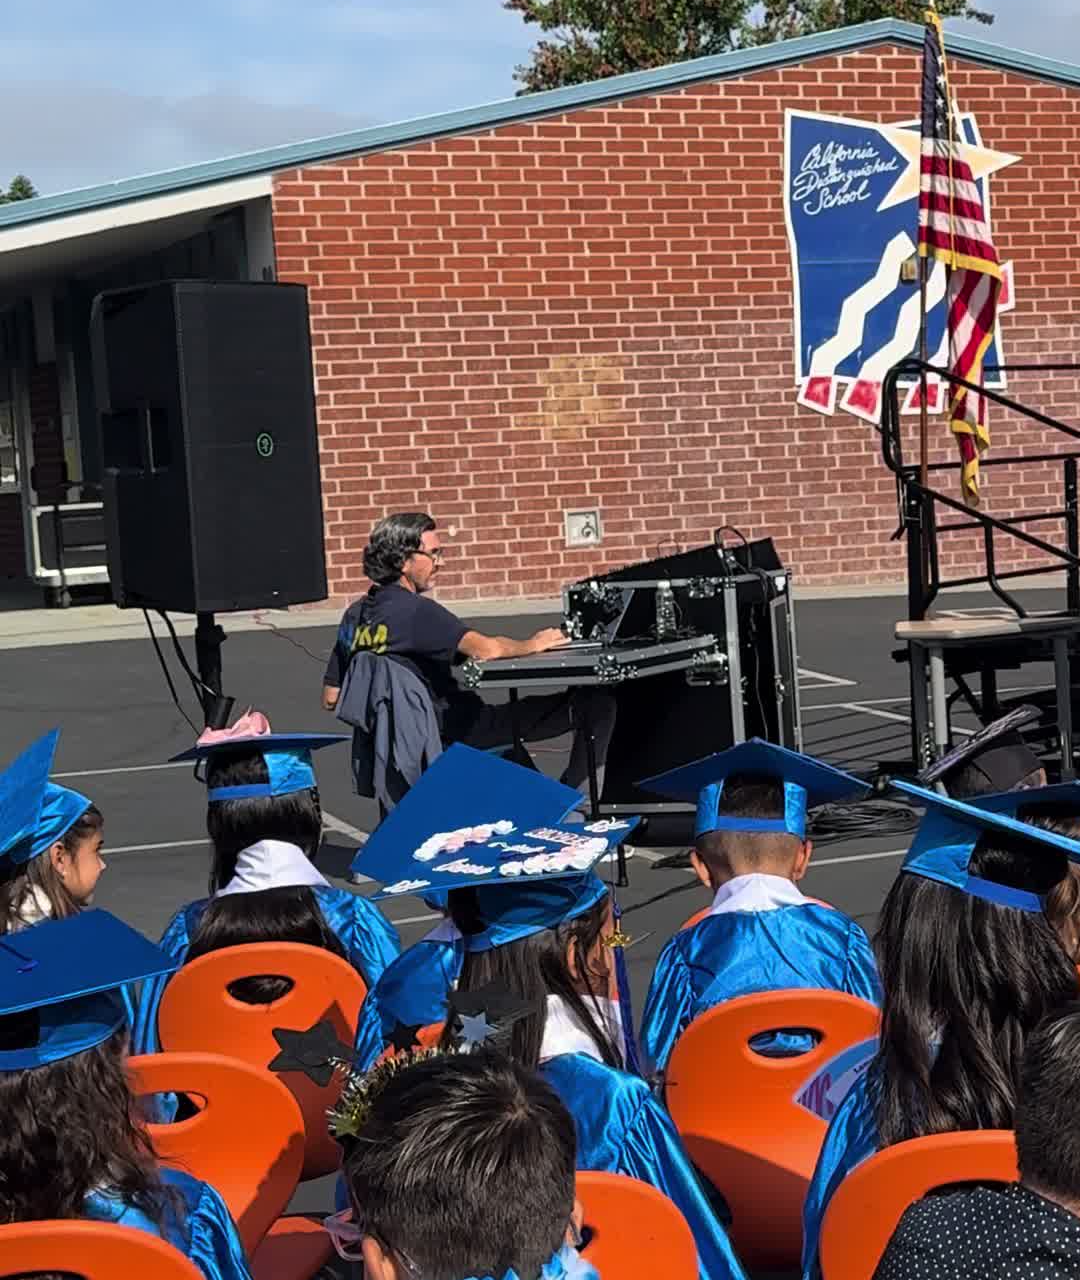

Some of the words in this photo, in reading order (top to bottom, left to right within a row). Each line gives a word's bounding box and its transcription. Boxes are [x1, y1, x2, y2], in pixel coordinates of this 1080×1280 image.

[801, 141, 880, 175] California
[792, 157, 899, 201] Distinguished
[803, 179, 872, 215] School
